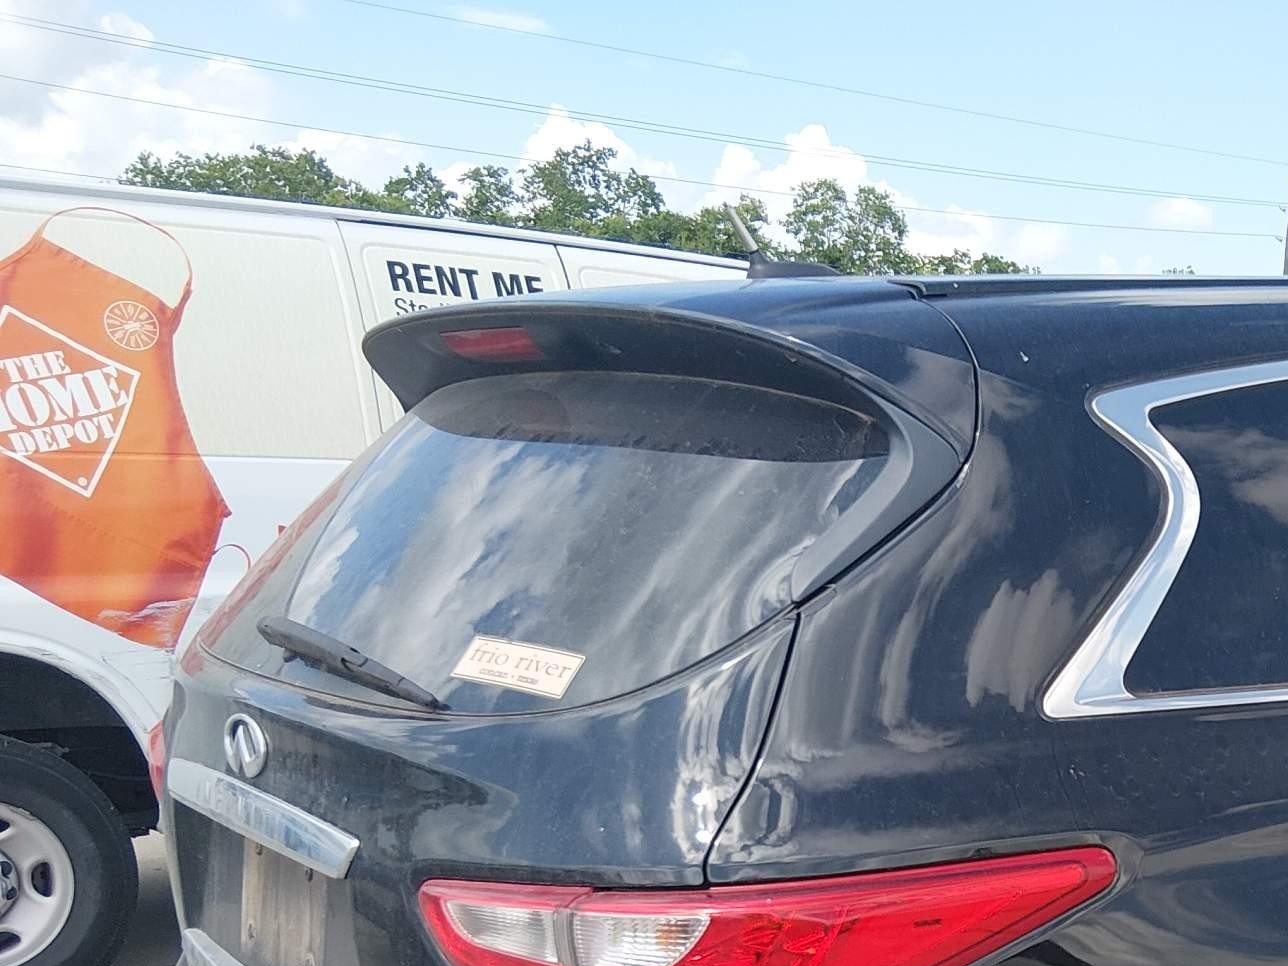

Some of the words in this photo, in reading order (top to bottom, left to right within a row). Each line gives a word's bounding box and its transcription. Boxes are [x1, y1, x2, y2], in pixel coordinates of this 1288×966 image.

[386, 260, 479, 300] RENT
[492, 271, 544, 297] ME
[0, 350, 71, 383] THE
[8, 413, 115, 456] DEPOT
[514, 653, 573, 678] river
